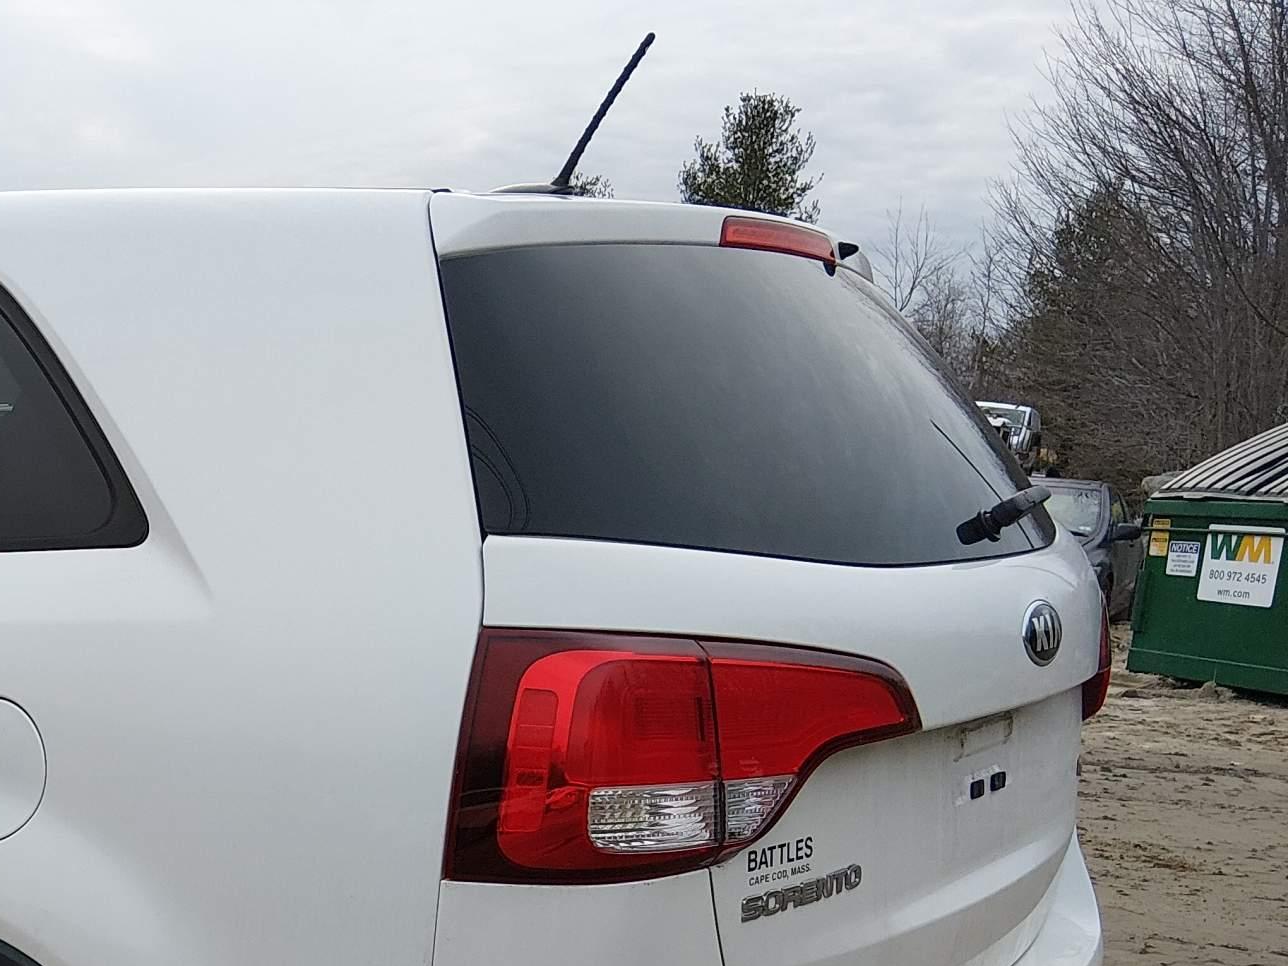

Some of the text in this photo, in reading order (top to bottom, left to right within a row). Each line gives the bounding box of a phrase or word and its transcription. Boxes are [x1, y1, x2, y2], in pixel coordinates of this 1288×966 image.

[1171, 543, 1198, 553] NOTICE
[1211, 533, 1272, 564] WM
[1209, 569, 1267, 584] 800 972 4545
[1217, 589, 1250, 599] wm.com
[748, 836, 813, 872] BATTLES
[749, 873, 770, 886] CAPE
[772, 869, 789, 880] COD,
[741, 864, 862, 923] SORENTO
